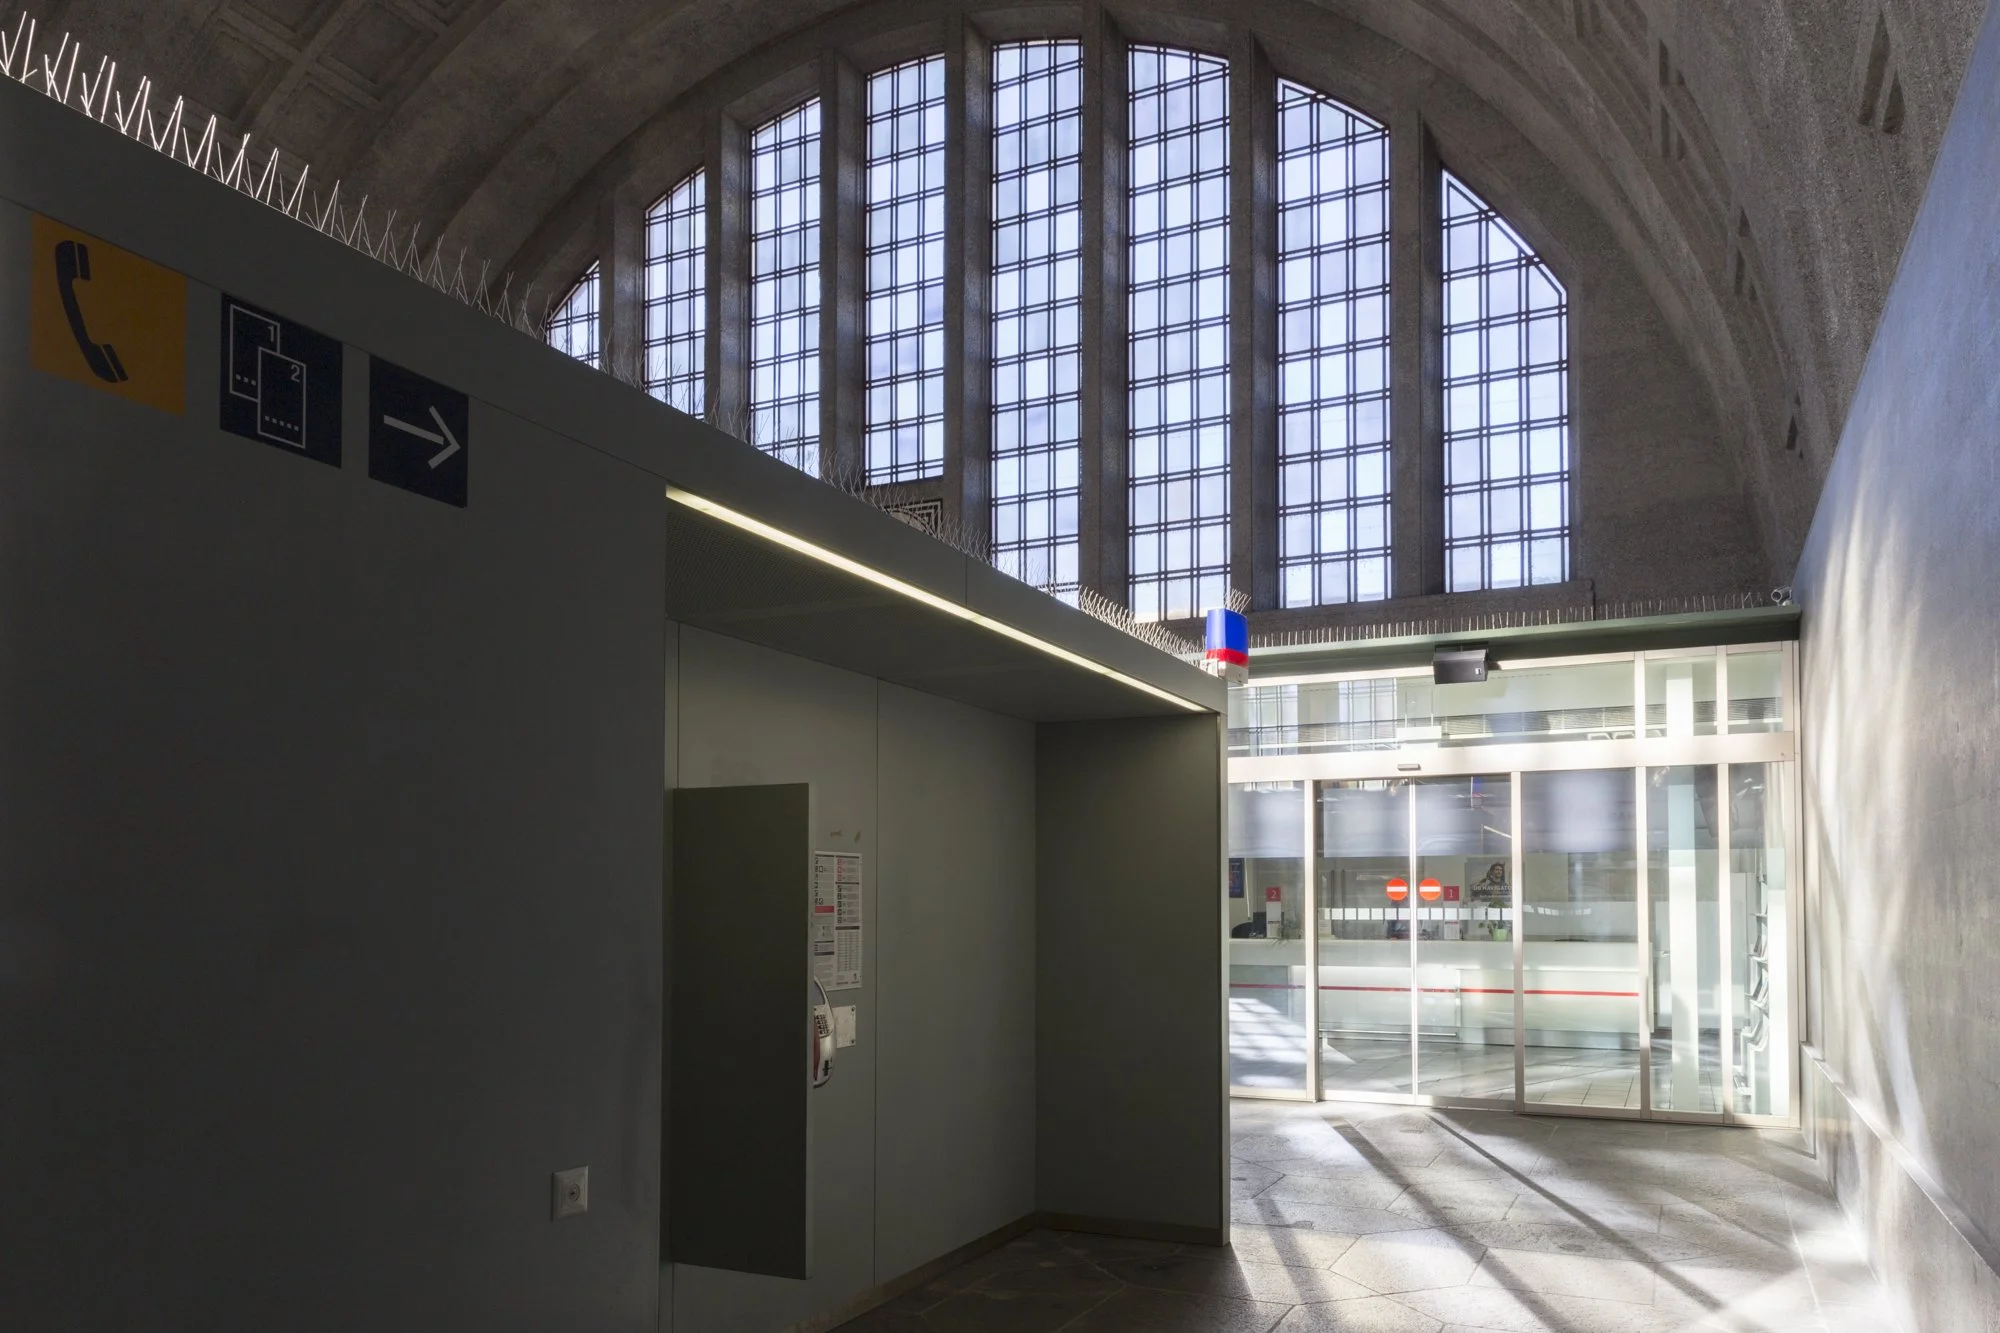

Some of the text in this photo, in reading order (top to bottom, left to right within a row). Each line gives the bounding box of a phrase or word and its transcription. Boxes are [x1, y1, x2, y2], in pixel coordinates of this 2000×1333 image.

[267, 325, 275, 342] 1
[290, 364, 300, 383] 2
[1270, 889, 1277, 899] 2
